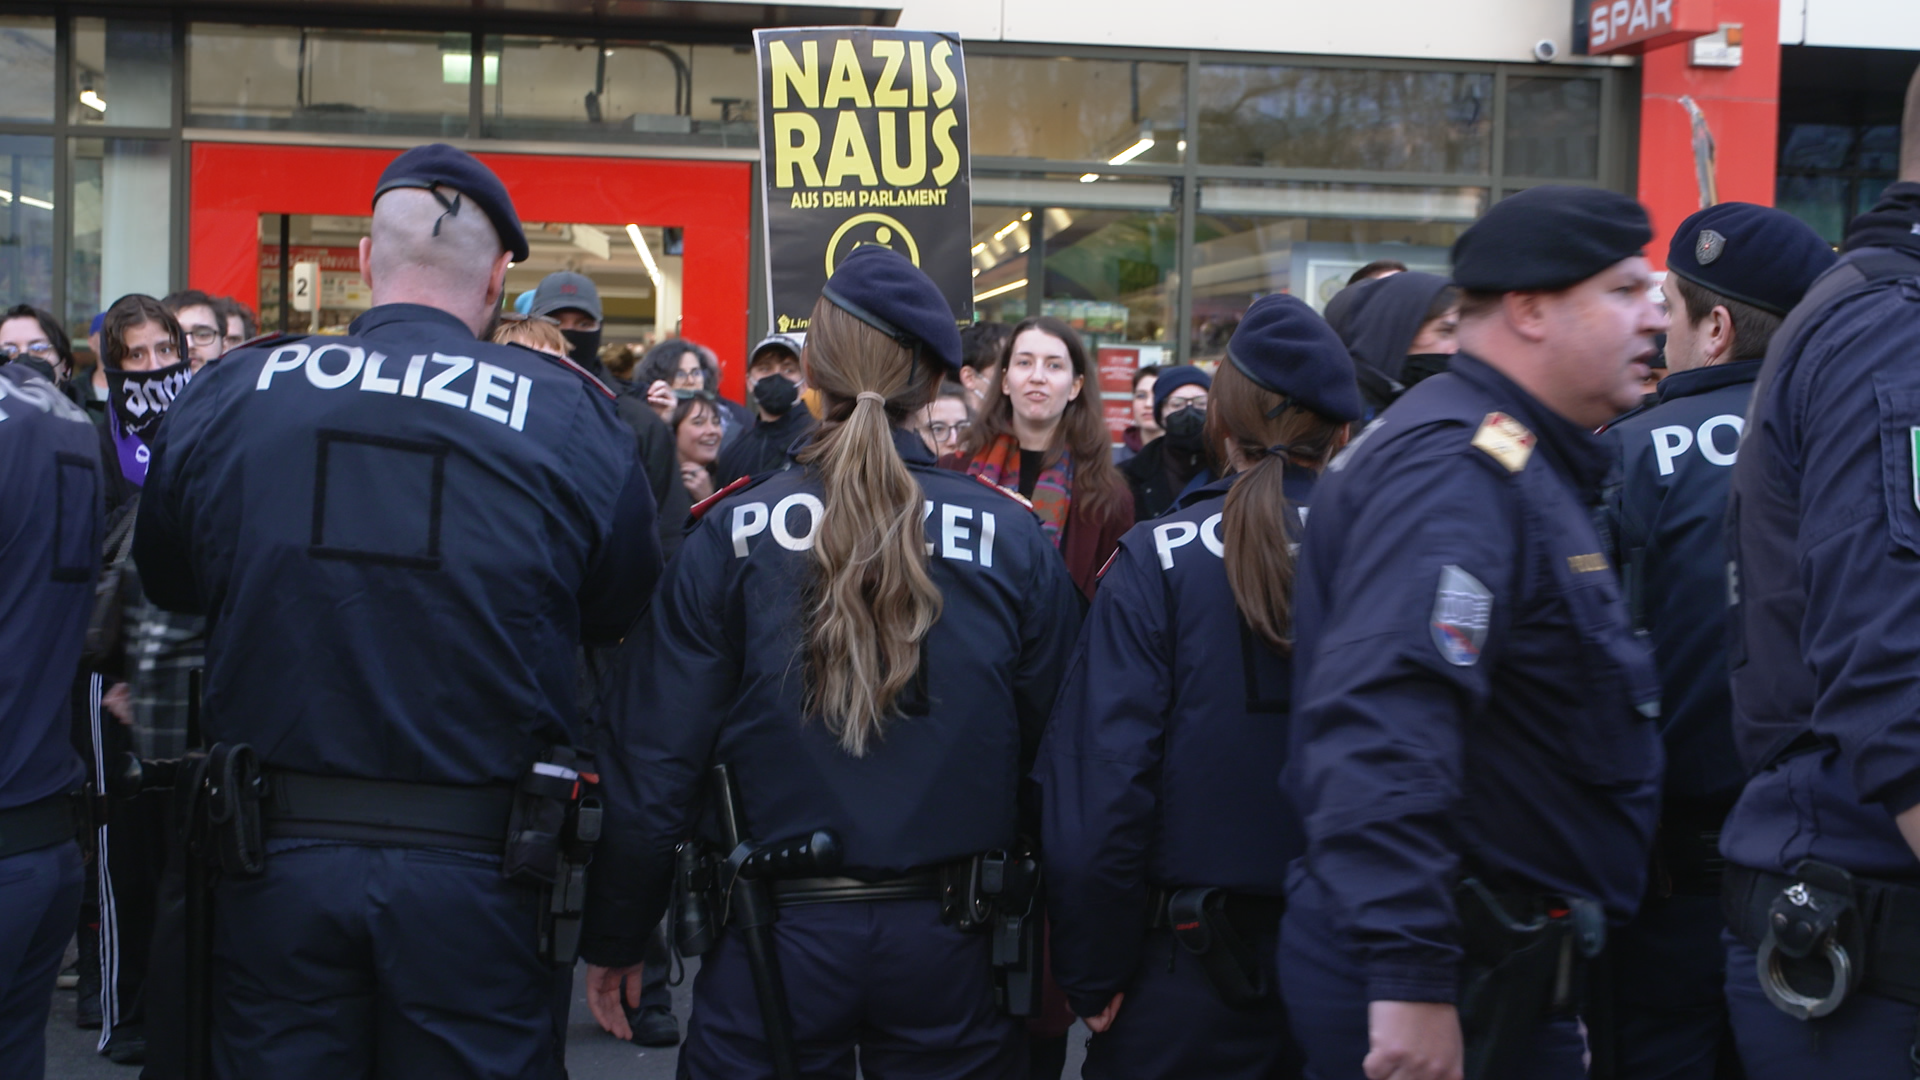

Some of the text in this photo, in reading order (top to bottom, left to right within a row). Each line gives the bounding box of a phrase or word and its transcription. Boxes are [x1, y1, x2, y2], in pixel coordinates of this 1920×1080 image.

[1591, 0, 1673, 47] SPAR
[769, 39, 957, 109] NAZIS
[773, 108, 960, 188] RAUS
[791, 188, 948, 209] AUS DEM PARLAMENT
[296, 278, 308, 297] 2
[256, 343, 533, 432] POLIZEI
